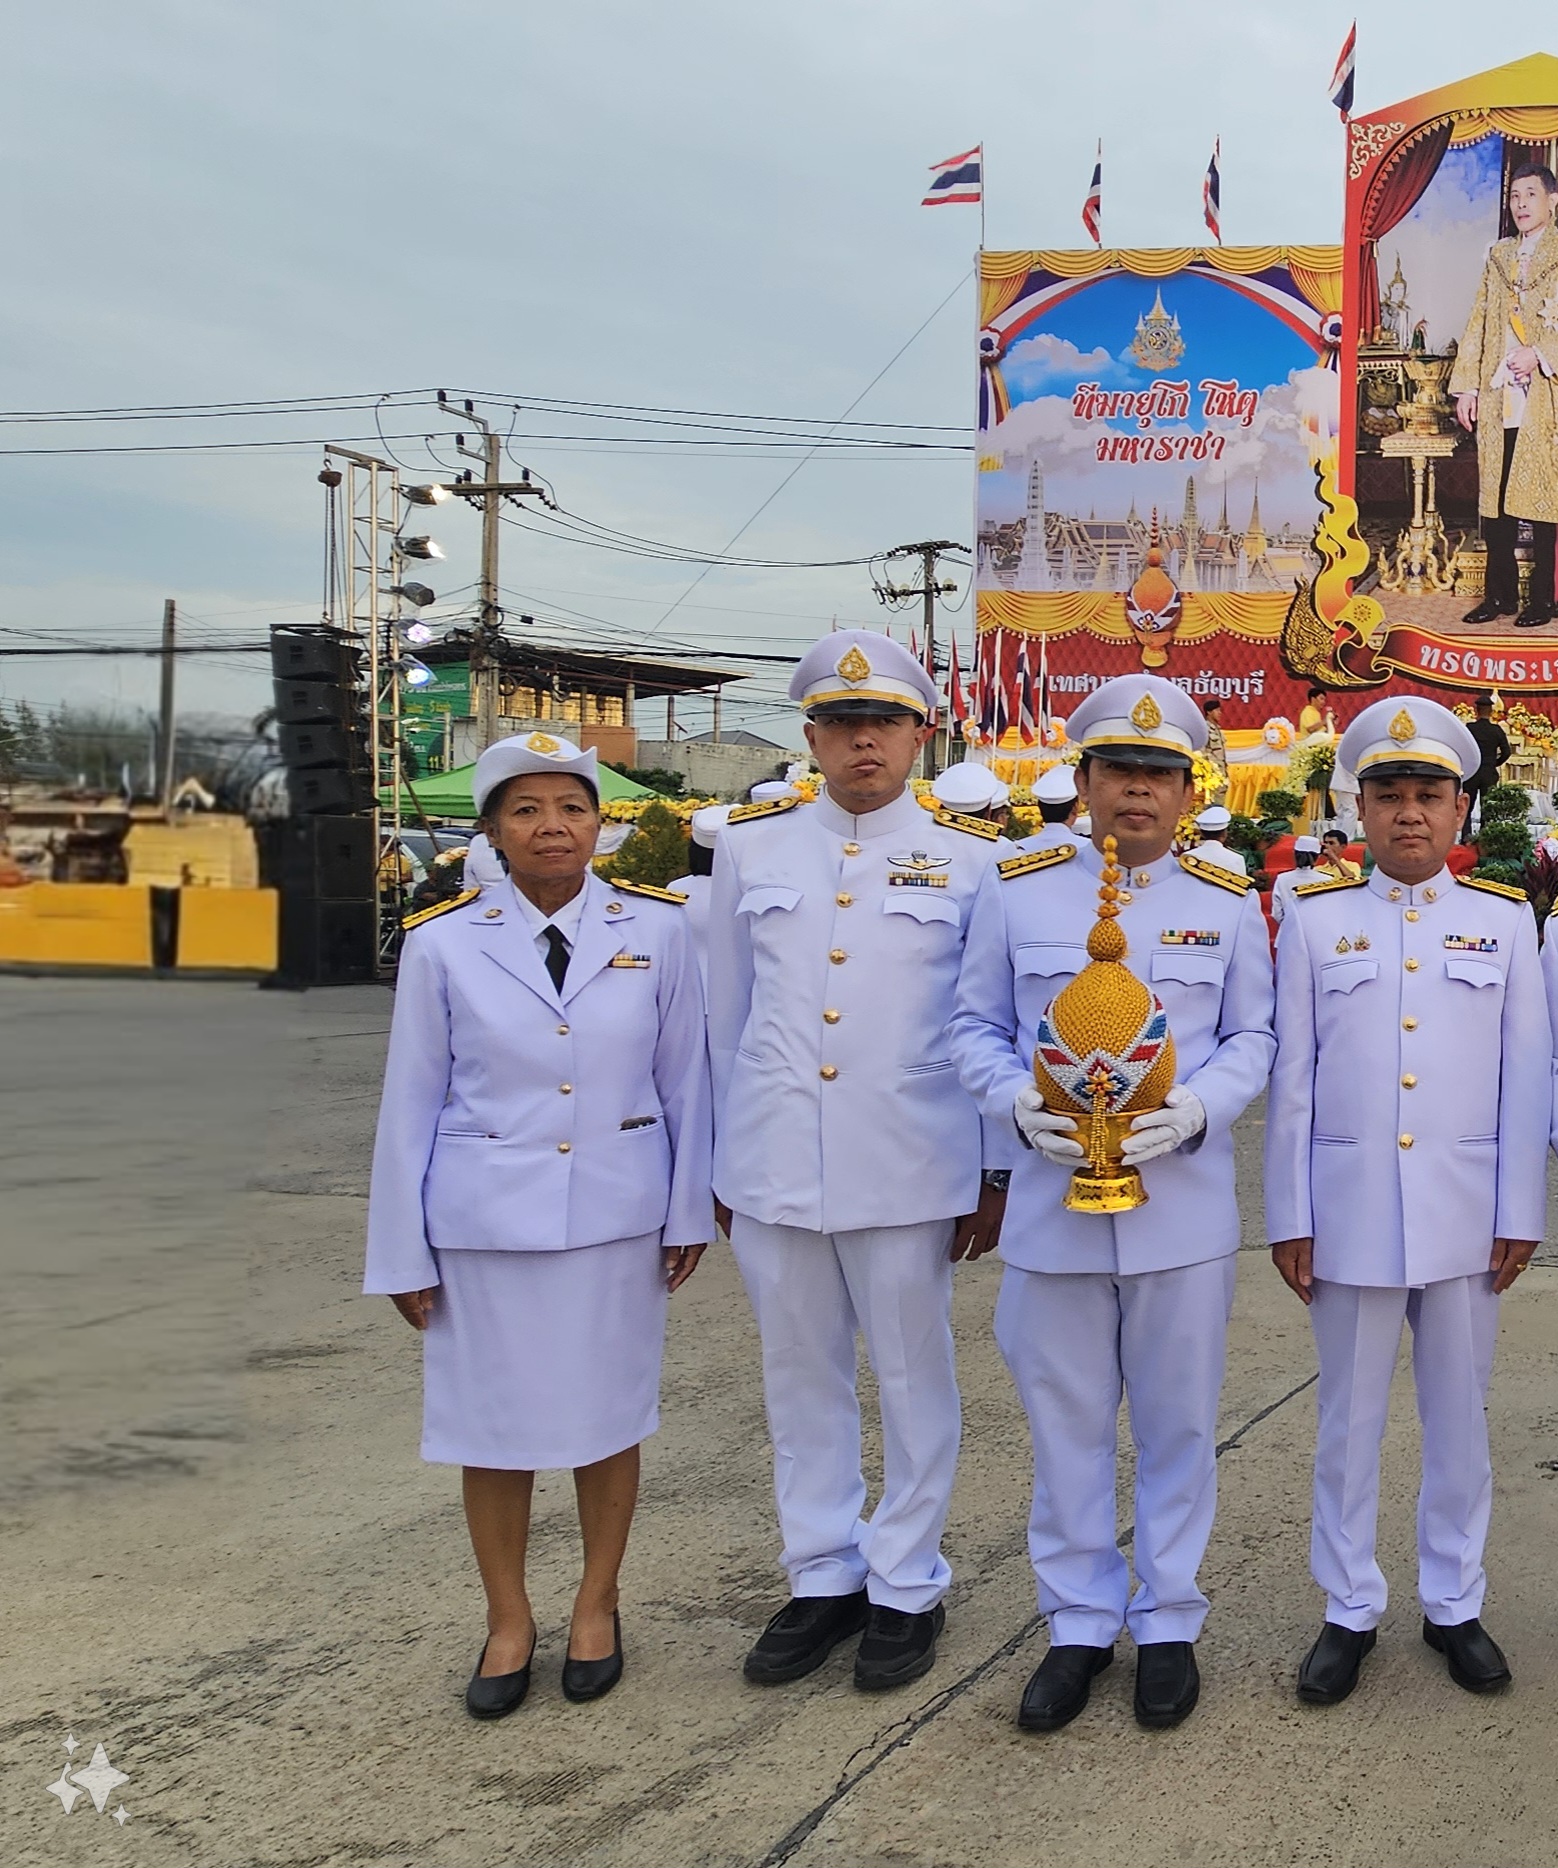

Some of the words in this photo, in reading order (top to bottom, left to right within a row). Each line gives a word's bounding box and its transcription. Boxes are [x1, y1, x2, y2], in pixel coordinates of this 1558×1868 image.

[1072, 380, 1191, 429] ทีฆายุโก
[1200, 379, 1259, 428] โหตุ
[1095, 430, 1227, 465] มหาราชา
